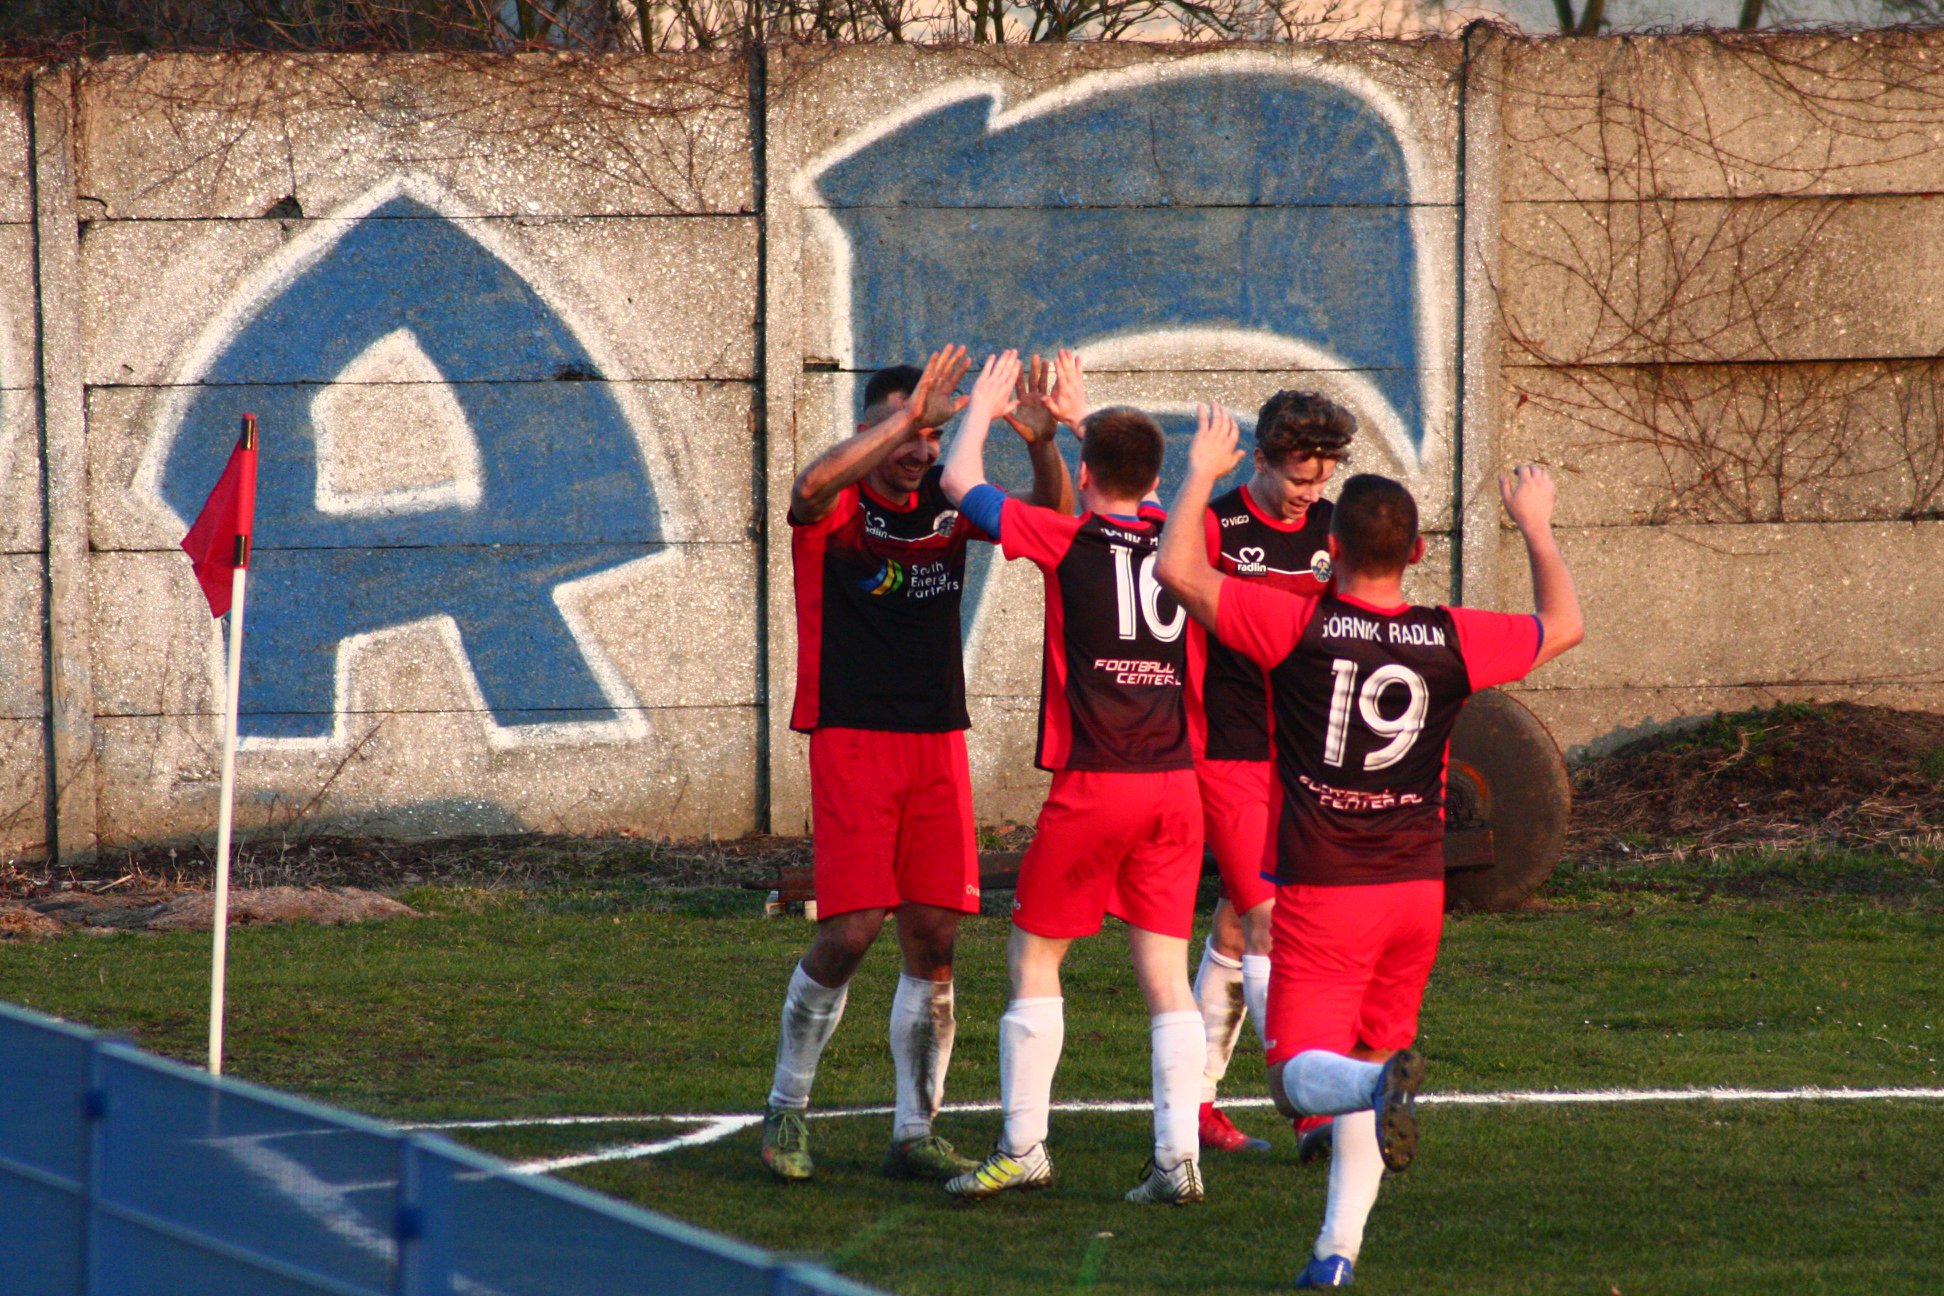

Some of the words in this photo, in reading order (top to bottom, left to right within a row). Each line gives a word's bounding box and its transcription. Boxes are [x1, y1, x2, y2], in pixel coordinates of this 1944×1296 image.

[1110, 544, 1187, 643] 16
[1237, 562, 1267, 573] radlin
[1094, 659, 1175, 674] FOOTBALL
[1324, 658, 1430, 771] 19
